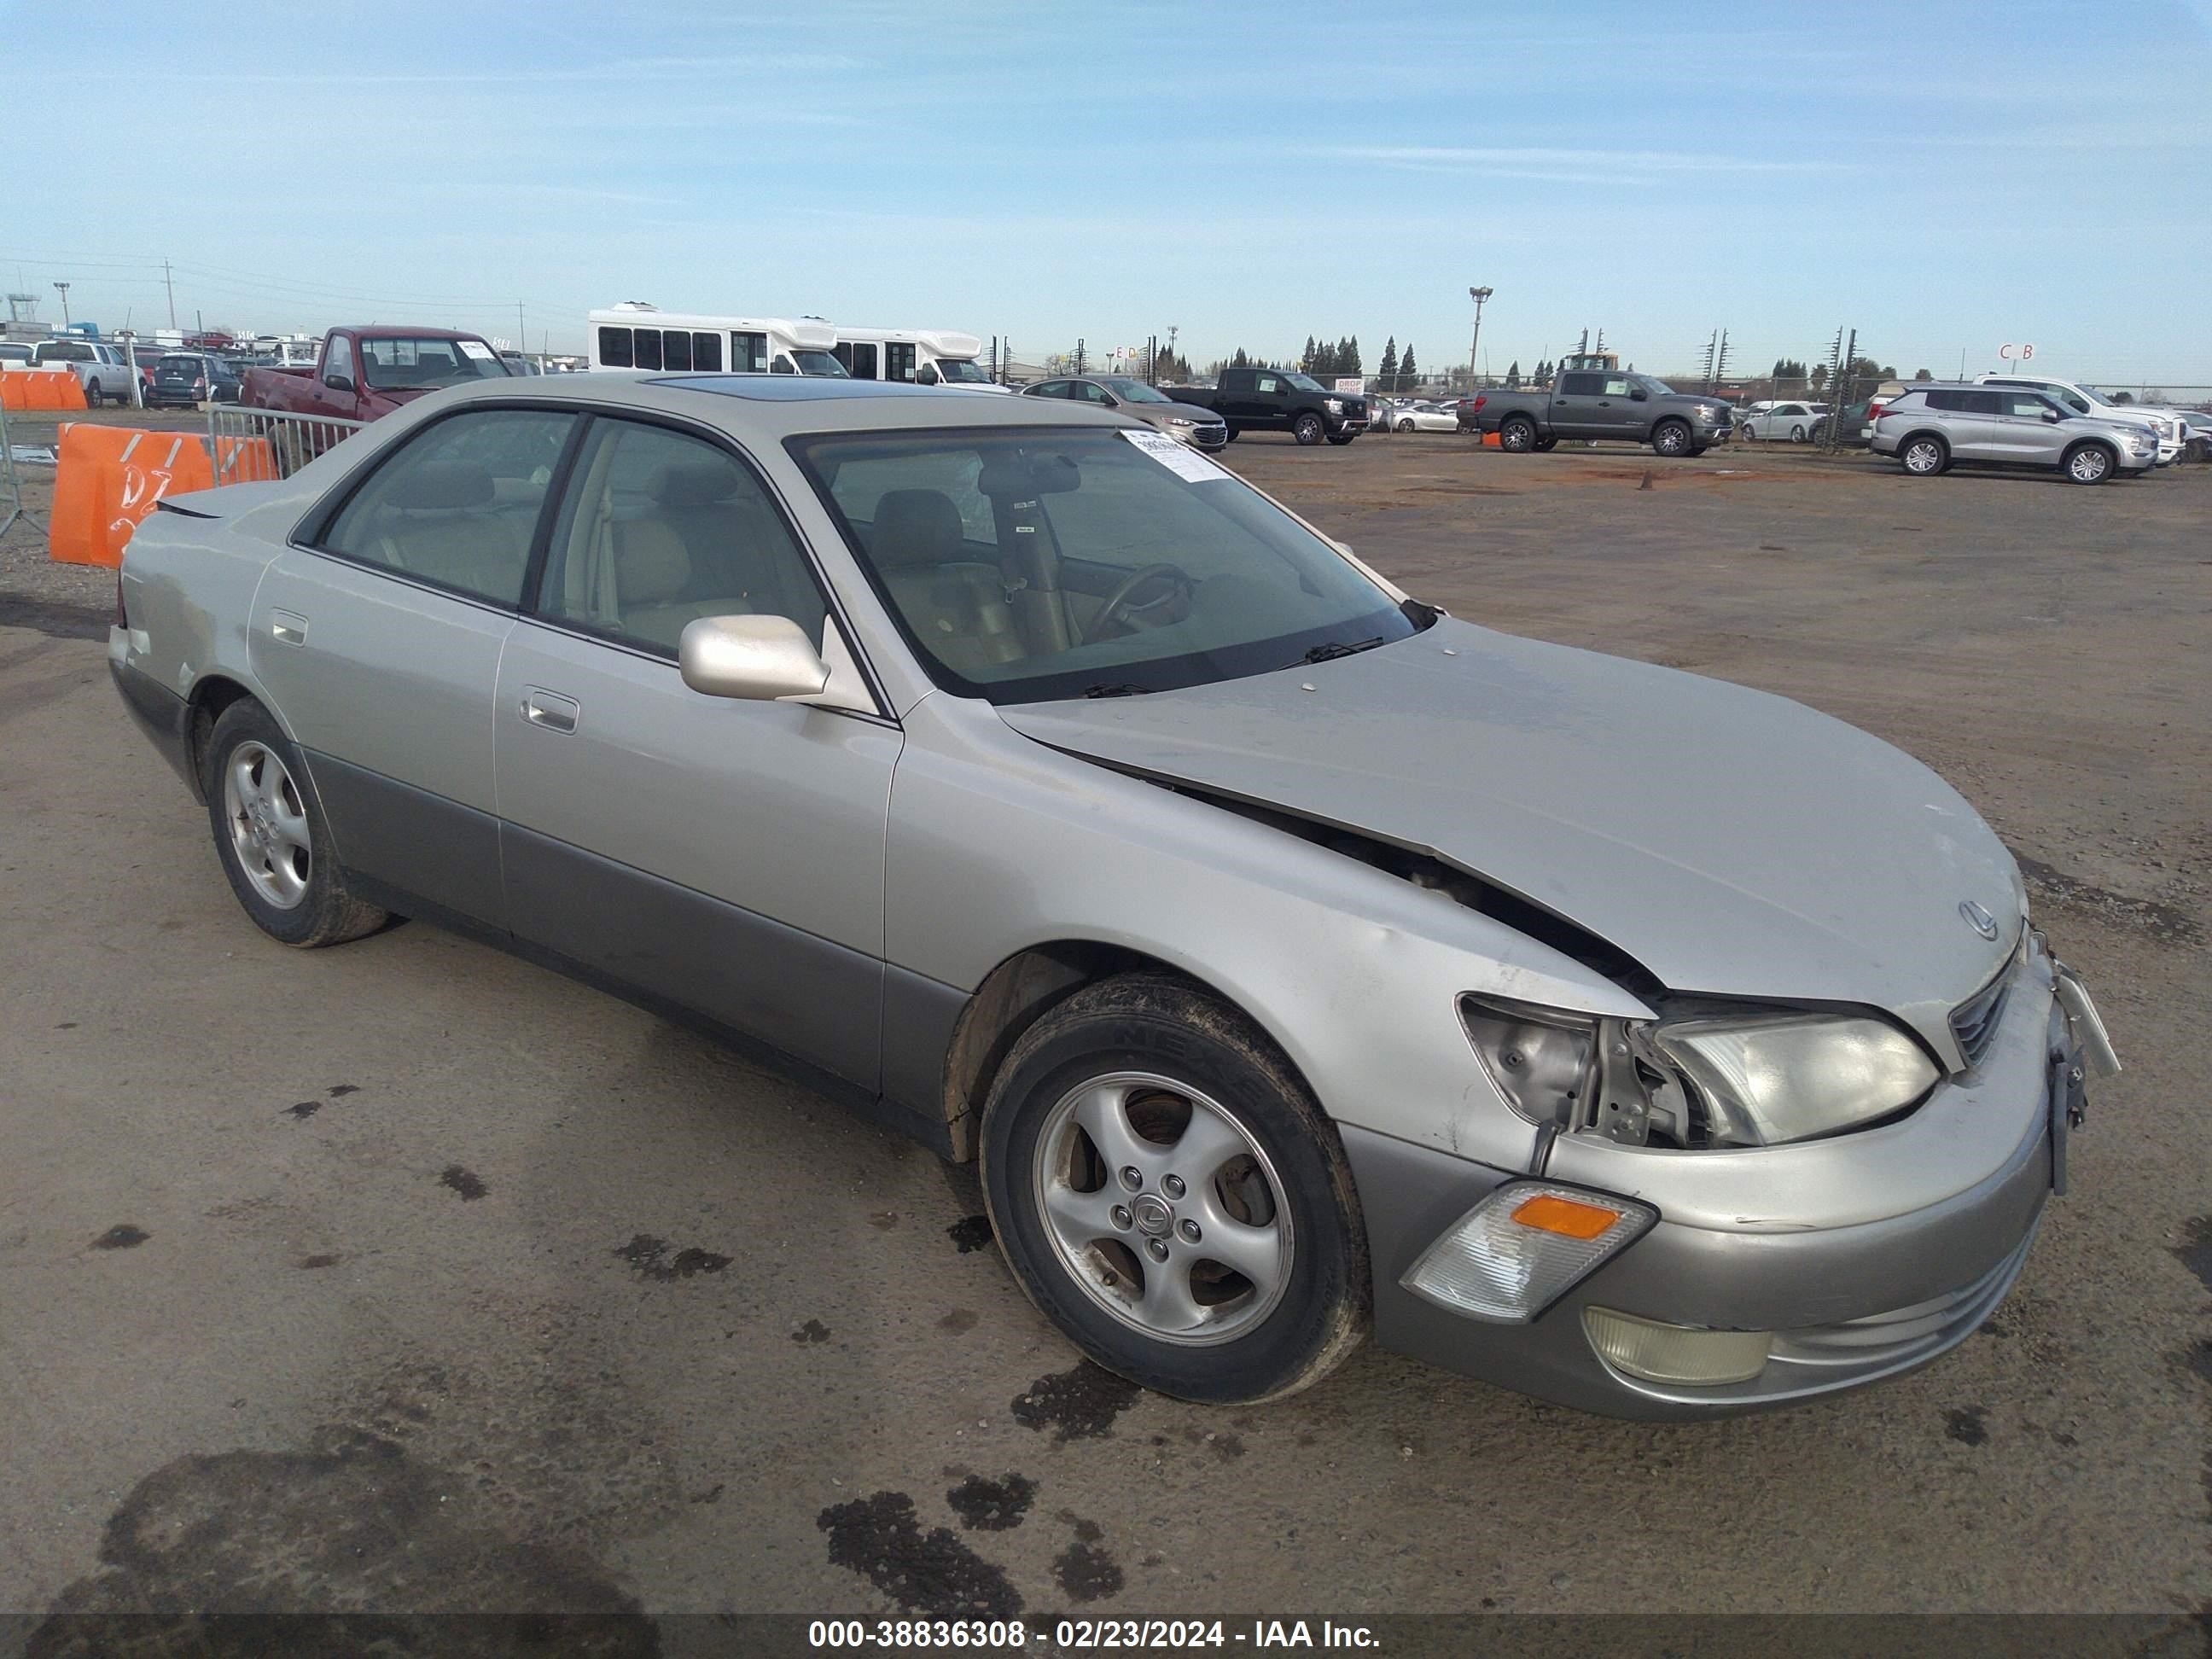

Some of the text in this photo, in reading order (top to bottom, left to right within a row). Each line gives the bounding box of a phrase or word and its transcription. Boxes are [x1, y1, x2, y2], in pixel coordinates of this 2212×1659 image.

[1116, 346, 1123, 358] E
[2000, 344, 2033, 359] C B
